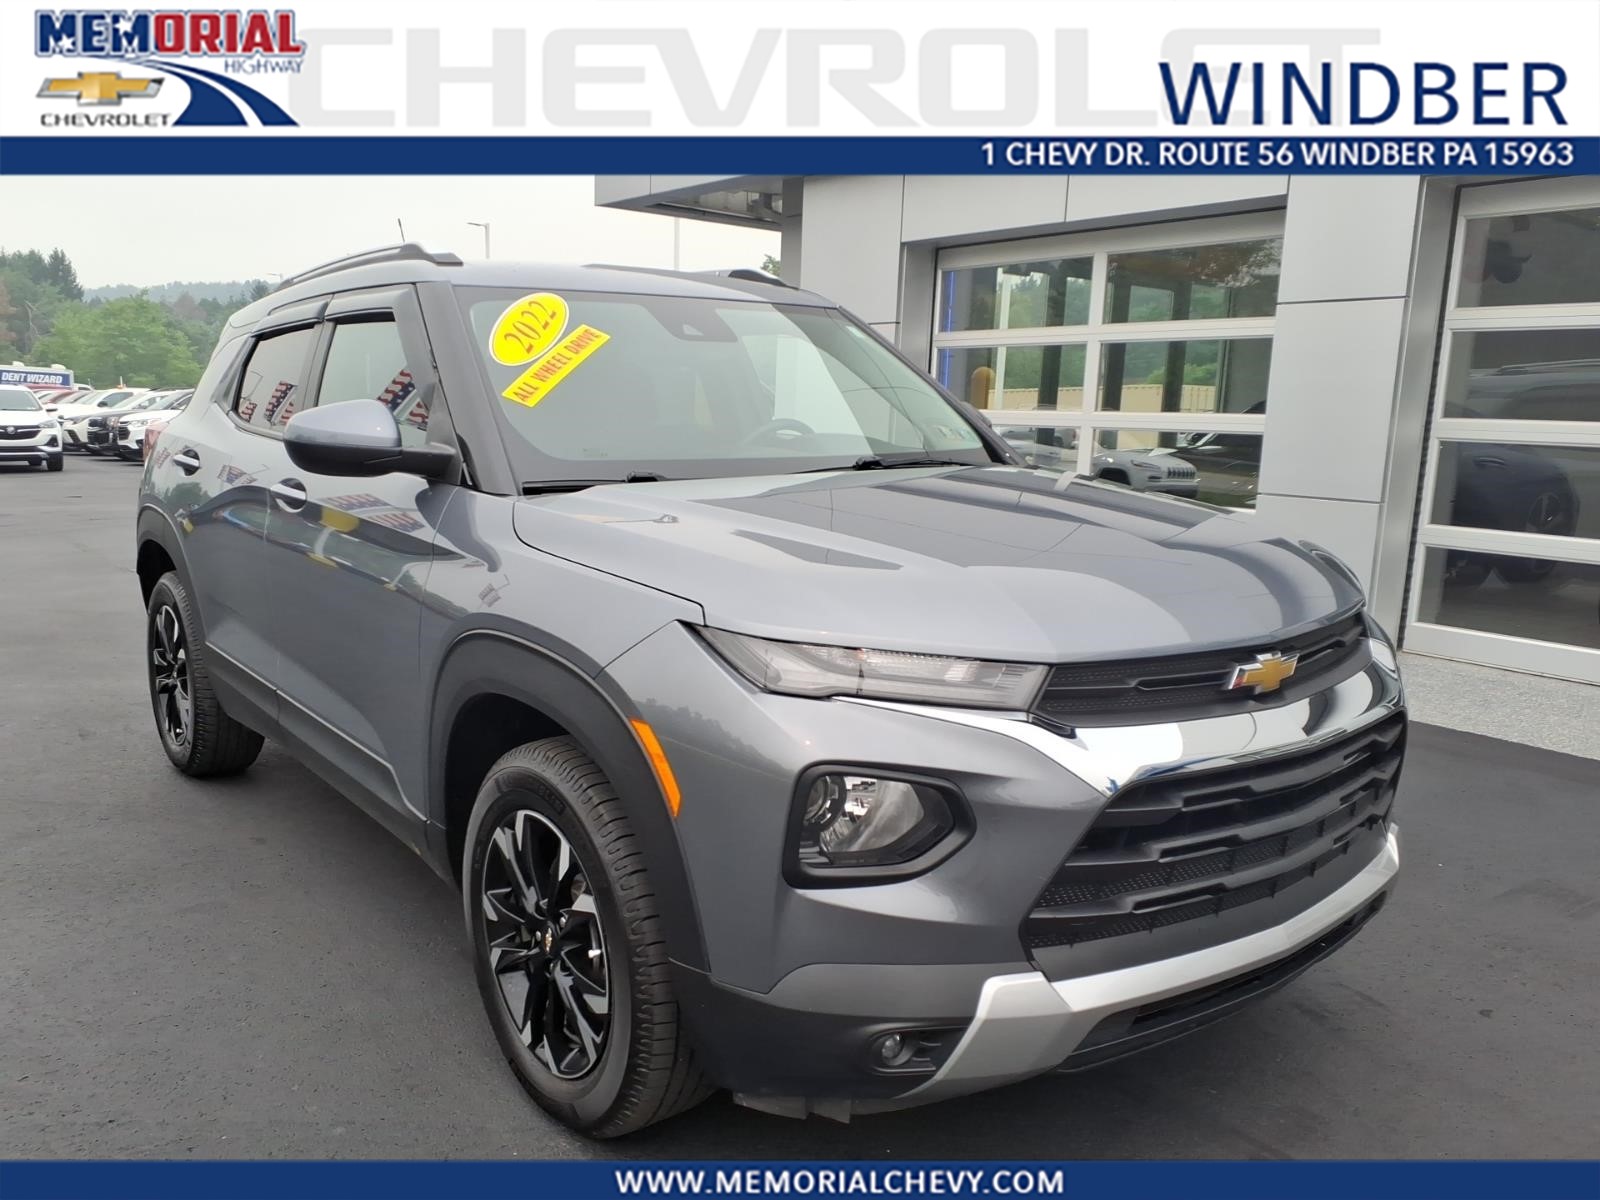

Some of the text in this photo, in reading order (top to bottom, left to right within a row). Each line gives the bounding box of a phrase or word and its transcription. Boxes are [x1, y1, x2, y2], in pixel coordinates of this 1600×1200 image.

[503, 300, 557, 355] 2022
[1, 372, 63, 384] DENT WIZARD
[512, 328, 600, 403] ALL WHEEL DRIVE
